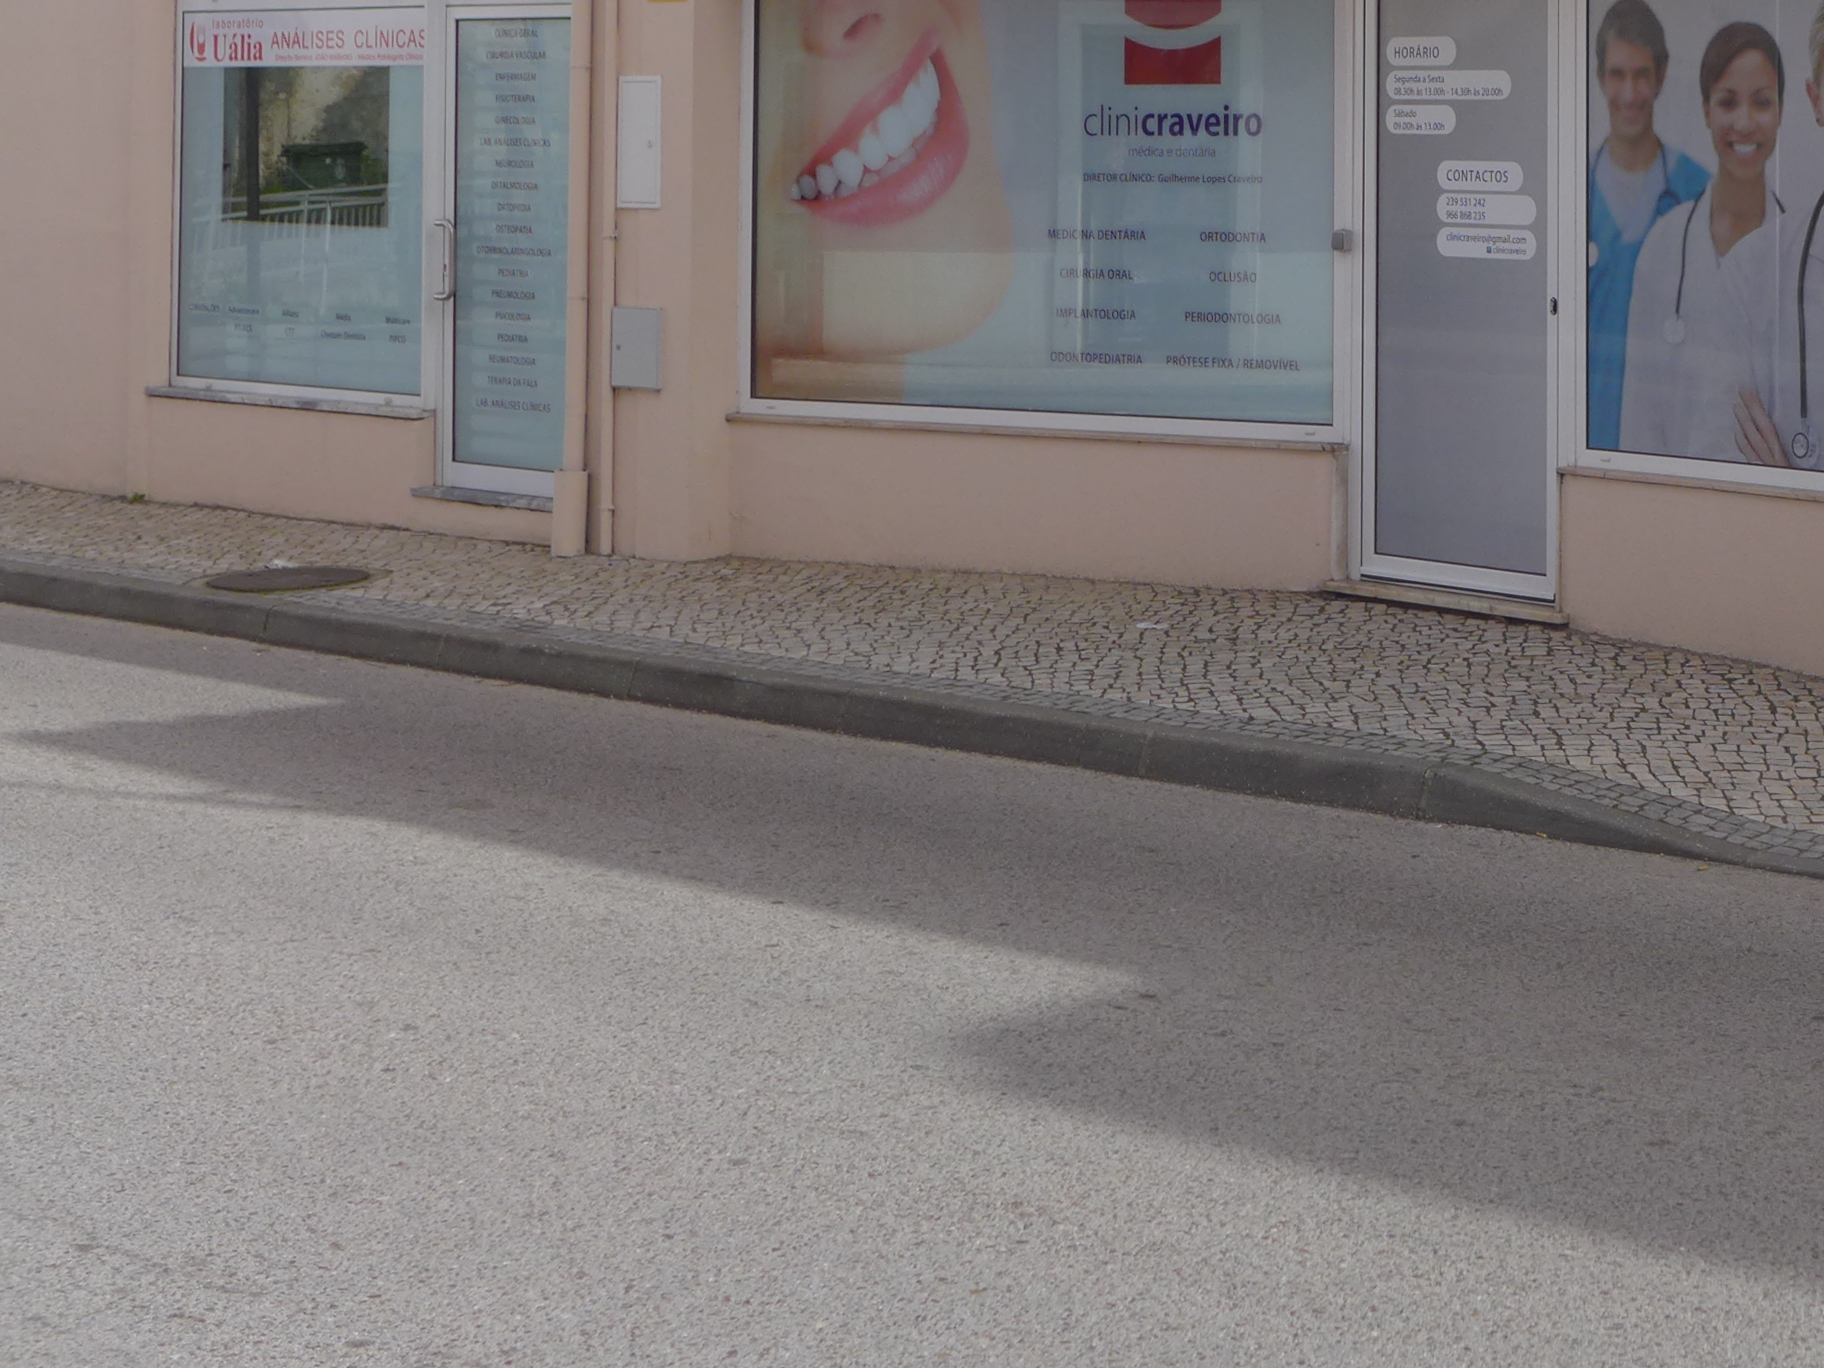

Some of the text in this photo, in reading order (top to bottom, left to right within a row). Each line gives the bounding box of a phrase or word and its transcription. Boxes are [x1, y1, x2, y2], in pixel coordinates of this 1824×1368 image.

[212, 19, 264, 29] laboratório
[270, 25, 425, 50] ANÁLISES CLÍNICAS
[213, 33, 264, 62] Uália
[1394, 44, 1440, 59] HORÁRIO
[495, 72, 536, 81] ENFERMAGEM
[1394, 75, 1421, 85] Segunda
[1428, 75, 1445, 83] Sexta
[495, 94, 535, 103] FISIOTERAPIA
[1393, 109, 1417, 118] Sábado
[495, 116, 535, 125] GINECOLOGIA
[1083, 104, 1263, 137] clinicraveiro
[1128, 145, 1216, 157] médica e dentária
[495, 159, 534, 168] NEUROLOGIA
[1083, 171, 1263, 185] DIRETOR CLÍNICO: Guilherme Lopes Craveiro
[1446, 169, 1509, 183] CONTACTOS
[491, 181, 538, 190] OFTALMOLOGIA
[1446, 196, 1486, 207] 239 531 242
[497, 203, 531, 213] ORTOPEDIA
[495, 225, 532, 234] OSTEOPATIA
[1048, 228, 1146, 241] MEDICINA DENTÁRIA
[1200, 232, 1266, 243] ORTODONTIA
[498, 268, 528, 278] PEDIATRIA
[1060, 268, 1133, 280] CIRURGIA ORAL
[1209, 270, 1257, 283] OCLUSÃO
[491, 290, 535, 300] PNEUMOLOGIA
[1056, 308, 1136, 320] IMPLANTOLOGIA
[1185, 311, 1281, 325] PERIODONTOLOGIA
[497, 333, 528, 343] PEDIATRIA
[488, 354, 536, 366] REUMATOLOGIA
[1050, 351, 1142, 364] ODONTOPEDIATRIA
[1166, 354, 1210, 368] PRÓTESE
[1212, 357, 1234, 369] FIXA
[1243, 358, 1300, 371] REMOVÍVEL
